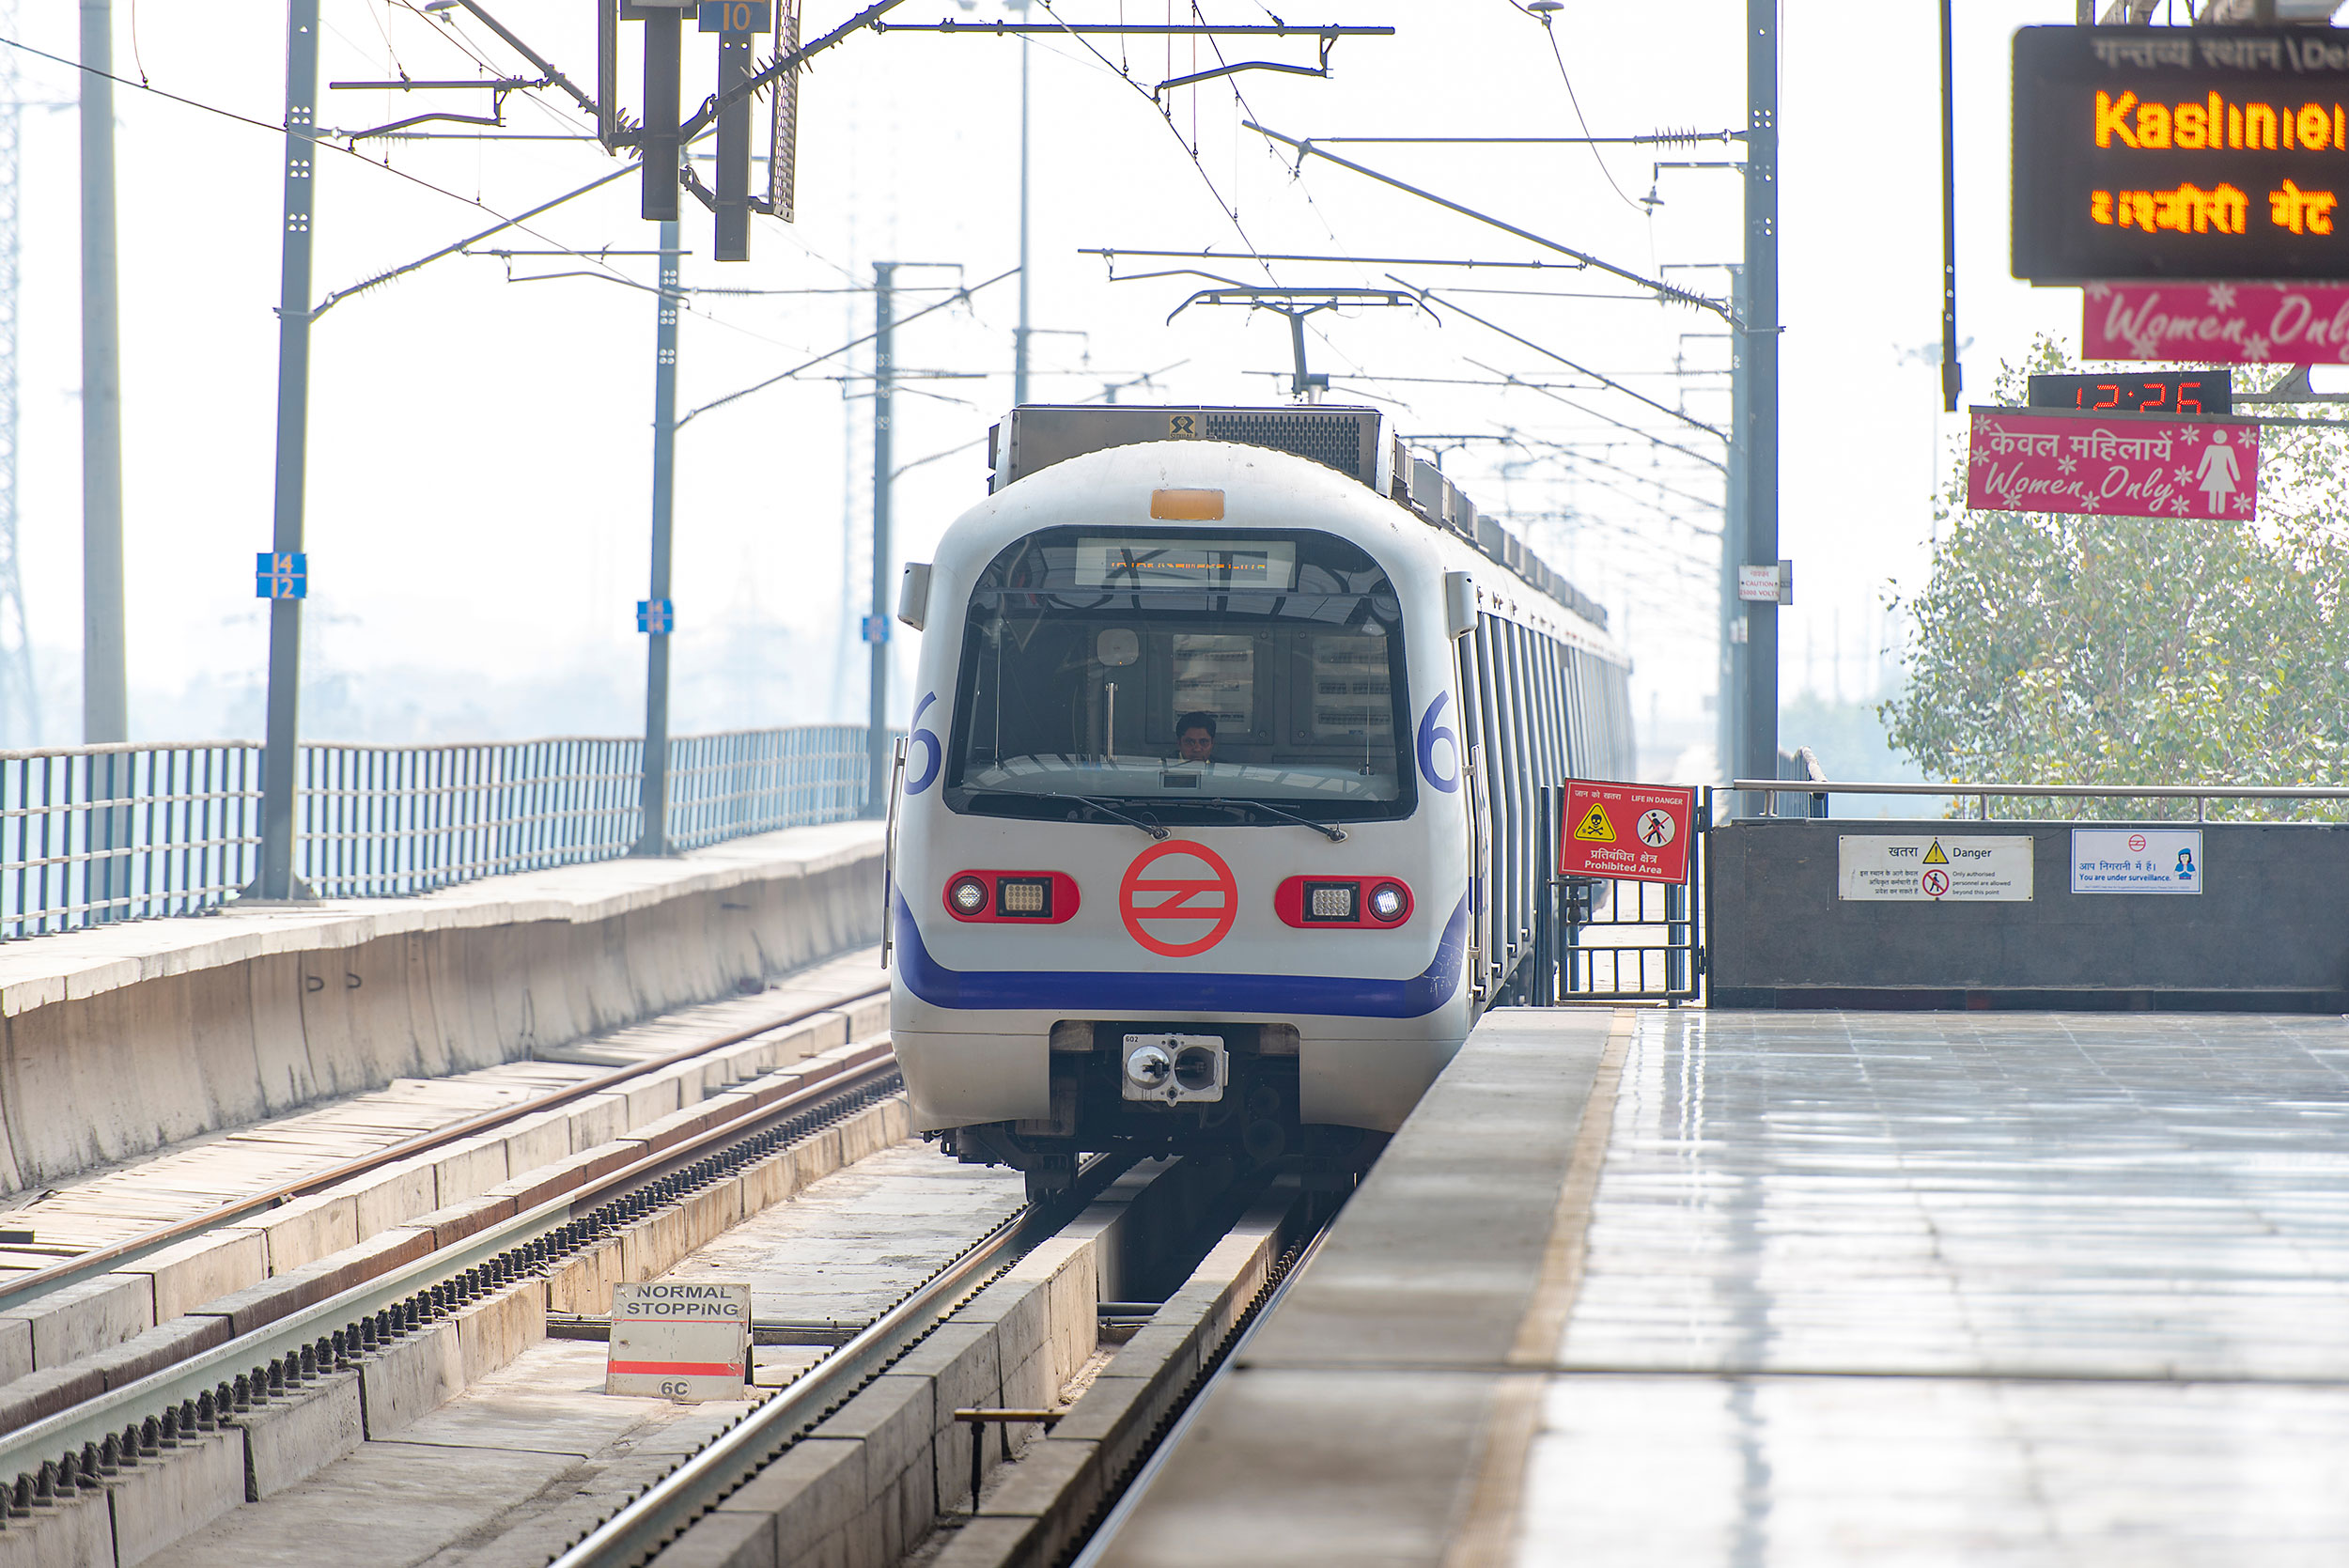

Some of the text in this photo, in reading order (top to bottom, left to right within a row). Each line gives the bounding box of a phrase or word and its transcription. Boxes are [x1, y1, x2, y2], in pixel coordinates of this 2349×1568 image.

[723, 3, 752, 31] 10
[2104, 293, 2248, 344] Women
[1989, 423, 2173, 462] केवल महिलायें
[1984, 462, 2175, 512] Women Only
[272, 553, 293, 573] 14
[272, 578, 294, 598] 12
[903, 691, 942, 796] 6
[1416, 690, 1460, 794] 6
[1591, 790, 1600, 799] को
[1603, 792, 1622, 800] खतरा
[1655, 797, 1683, 805] DANGER
[1889, 847, 1918, 857] खतरा
[1952, 847, 1992, 859] Danger
[1584, 860, 1662, 875] Prohibited Area
[2078, 862, 2095, 871] आप
[2100, 861, 2130, 871] निगरानी
[637, 1285, 732, 1298] NORMAL
[661, 1382, 688, 1396] 6C
